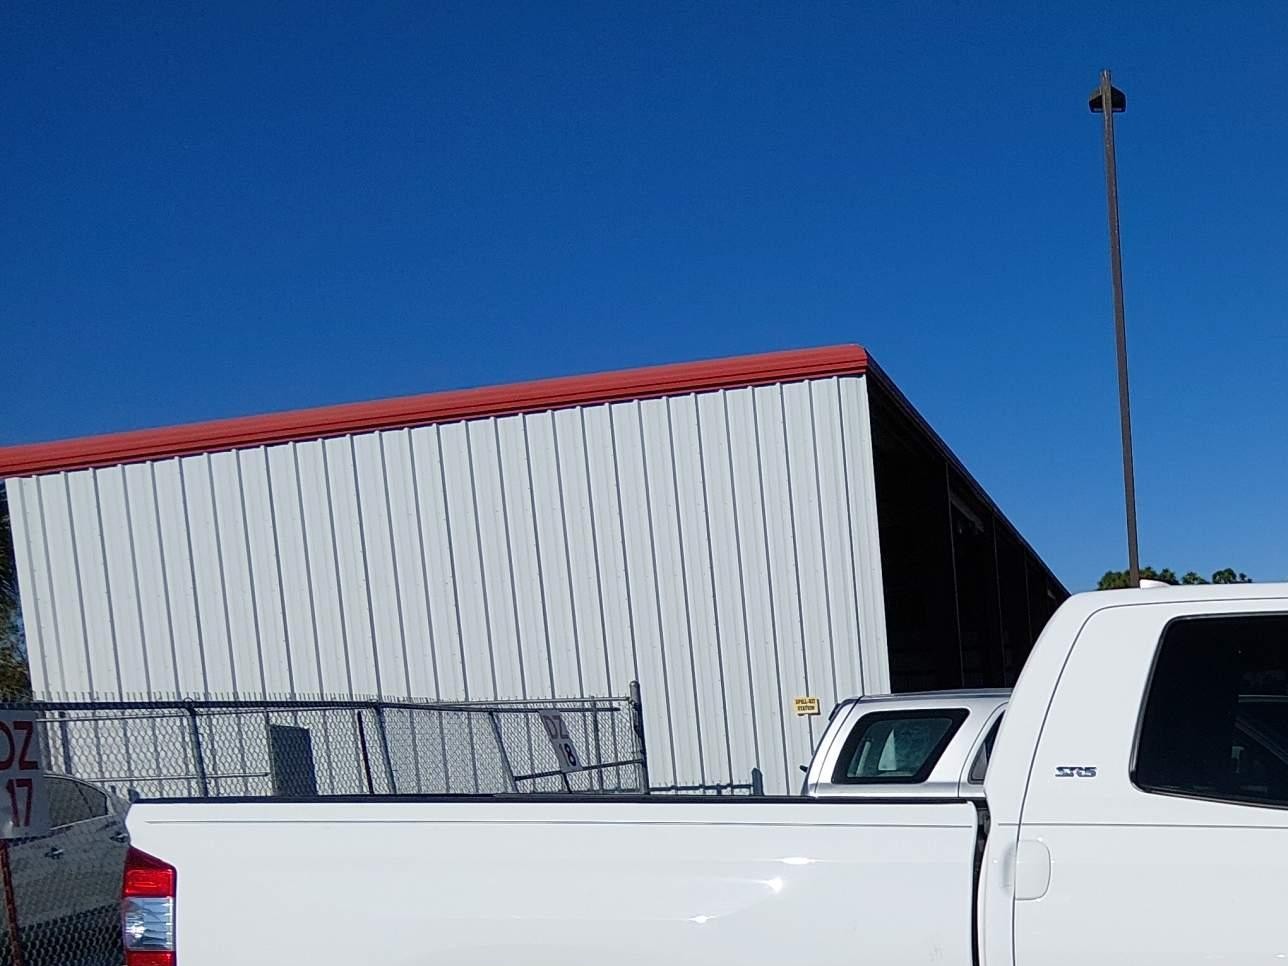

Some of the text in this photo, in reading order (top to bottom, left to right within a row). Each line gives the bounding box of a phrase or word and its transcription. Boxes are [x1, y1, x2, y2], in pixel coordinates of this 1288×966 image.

[558, 743, 577, 767] 18
[1055, 766, 1097, 778] SR5
[6, 778, 33, 828] 17
